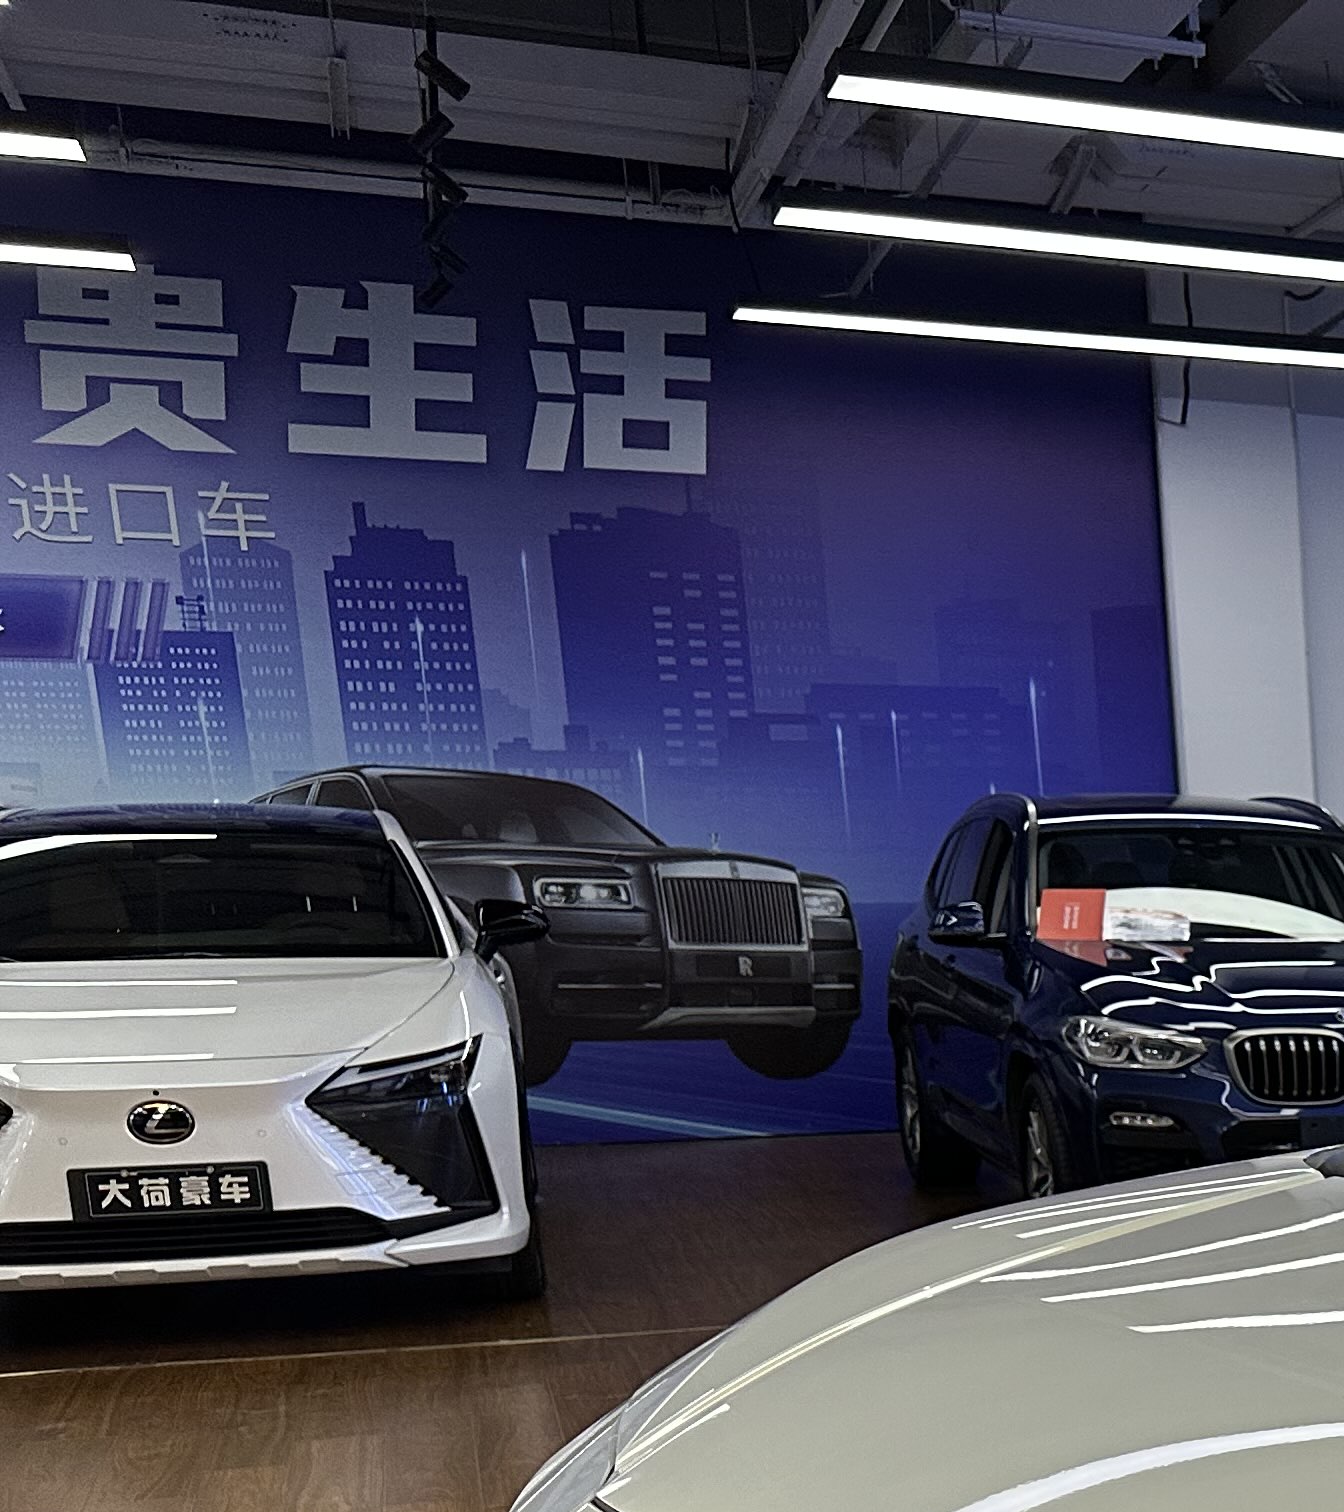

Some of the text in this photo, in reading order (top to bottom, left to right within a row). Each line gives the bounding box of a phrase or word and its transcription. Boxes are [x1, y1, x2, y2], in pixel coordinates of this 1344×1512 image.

[23, 263, 712, 475] 贵生活
[7, 472, 276, 551] 进口车
[98, 1173, 251, 1210] 大荷豪车
